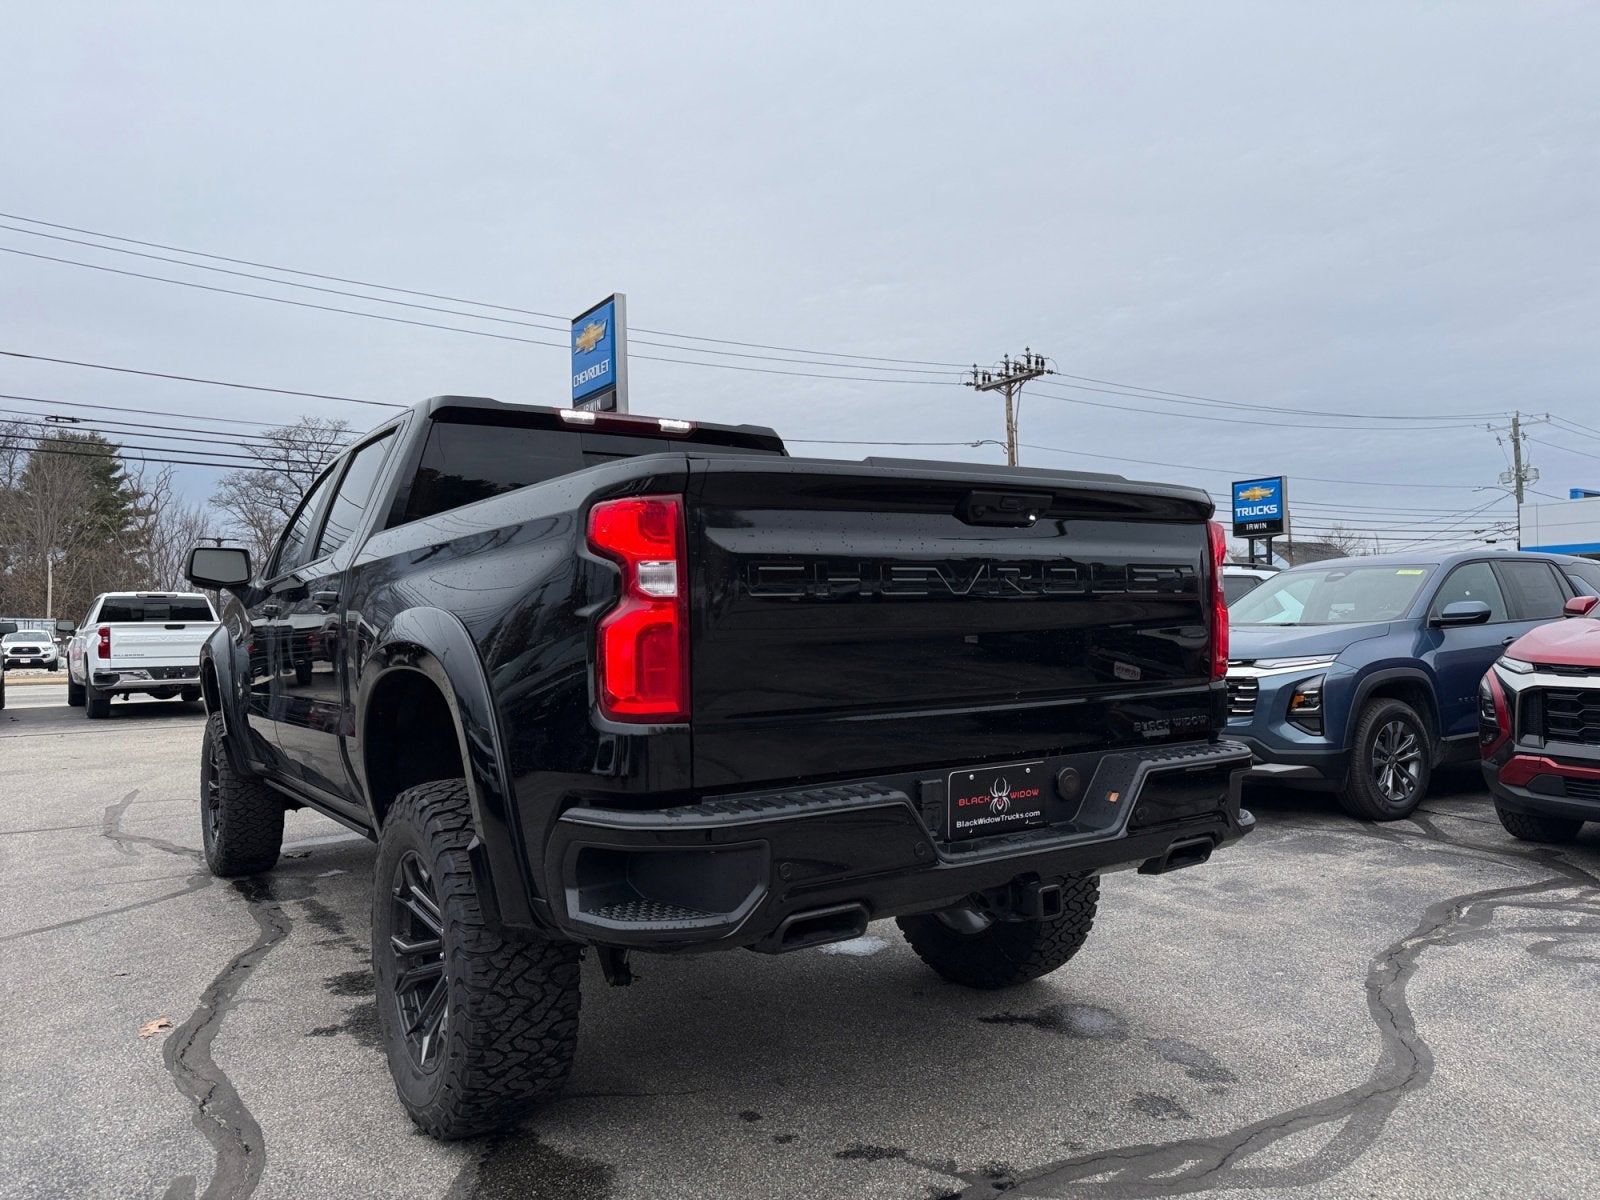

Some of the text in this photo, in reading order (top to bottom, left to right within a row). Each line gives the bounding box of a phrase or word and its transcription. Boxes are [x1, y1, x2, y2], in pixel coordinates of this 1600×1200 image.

[573, 358, 610, 388] CHEVROLET
[1235, 504, 1278, 517] TRUCKS
[1246, 522, 1267, 531] IRWIN
[748, 562, 1194, 597] CHEVROLET
[958, 788, 1040, 807] BLACK WIDOW
[956, 810, 1041, 829] BlackWidowTrucks.com
